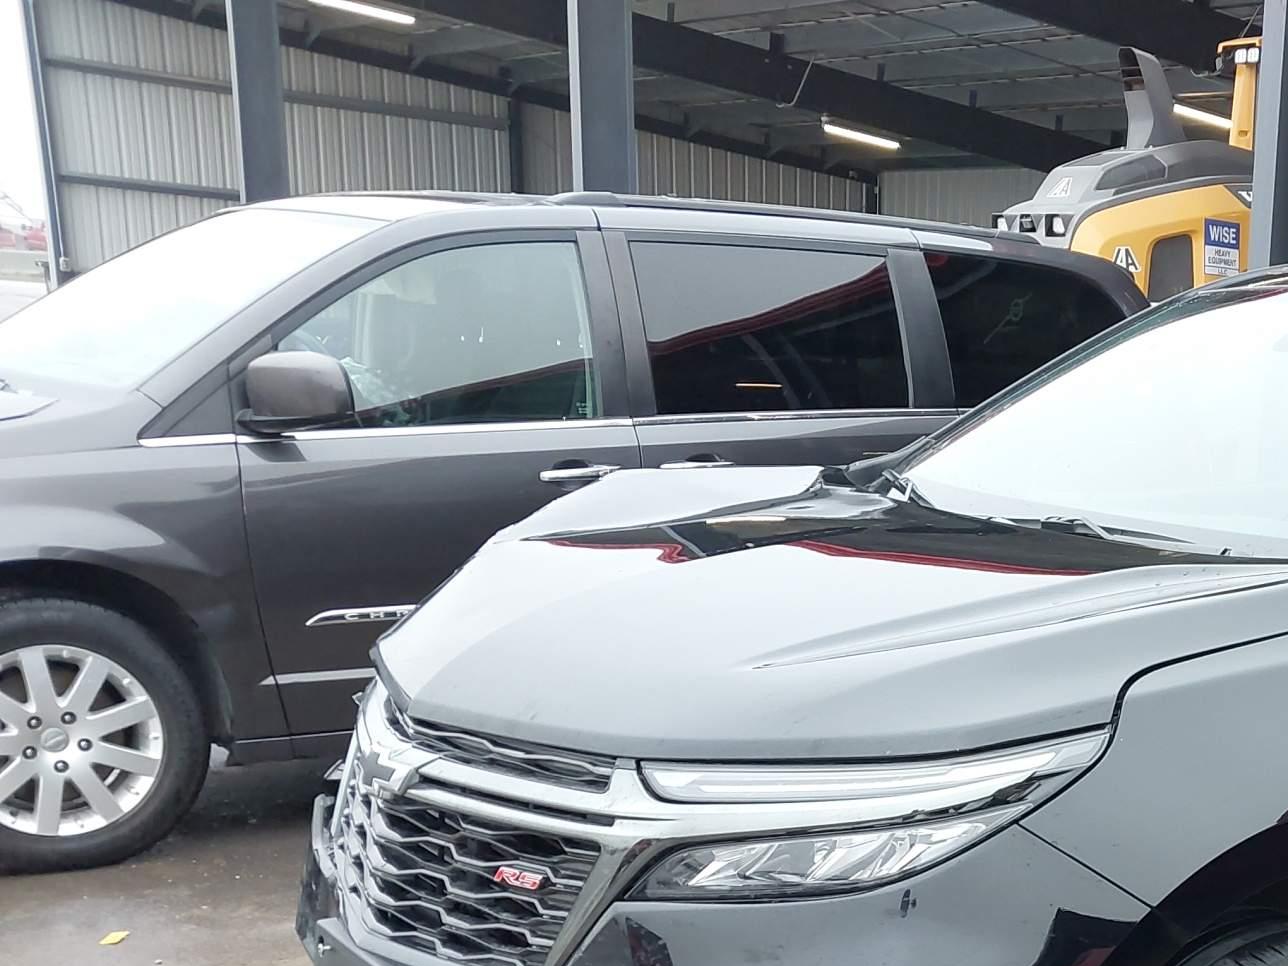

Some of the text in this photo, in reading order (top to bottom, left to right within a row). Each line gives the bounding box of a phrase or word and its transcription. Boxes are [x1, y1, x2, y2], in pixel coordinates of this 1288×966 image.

[1209, 224, 1237, 244] WISE
[1214, 248, 1231, 257] HEAVY
[1207, 256, 1237, 267] EQUIPMENT
[494, 866, 544, 889] RS
